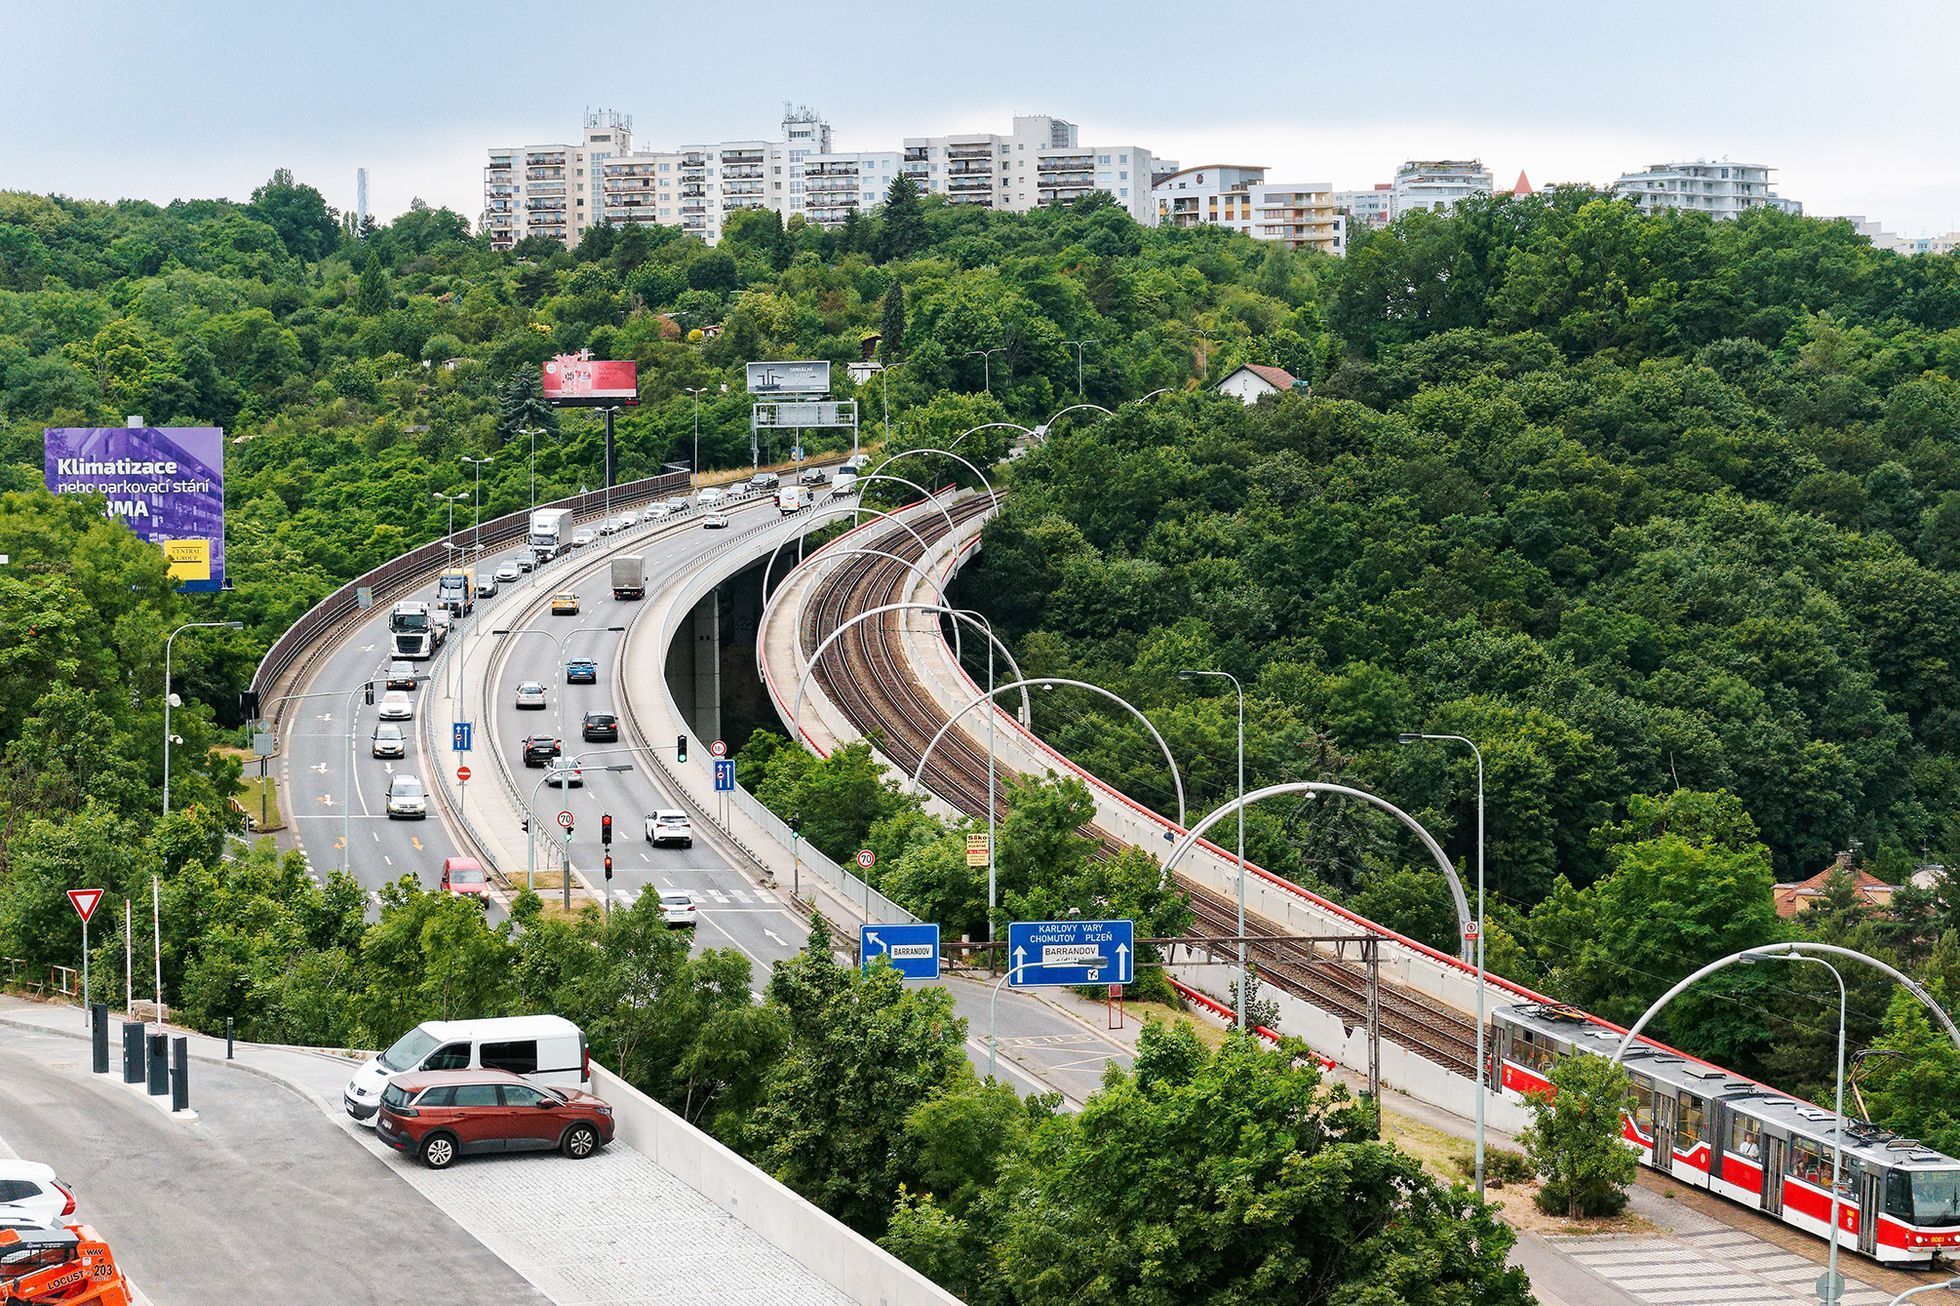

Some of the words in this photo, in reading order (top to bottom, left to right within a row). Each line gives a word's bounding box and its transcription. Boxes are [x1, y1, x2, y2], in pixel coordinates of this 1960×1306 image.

[58, 458, 177, 475] Klimatizace
[58, 480, 95, 493] nebo
[99, 479, 169, 493] parkovací
[173, 479, 210, 493] stání
[560, 814, 571, 823] 70
[861, 854, 872, 863] 70
[1039, 925, 1078, 933] KARLOVY
[1082, 924, 1104, 932] VARY
[1030, 934, 1075, 943] CHOMUTOV
[1085, 931, 1113, 941] PLZEŇ
[894, 947, 930, 956] BARRANDOV
[1045, 947, 1096, 956] BARRANDOV
[94, 1264, 113, 1276] 203
[47, 1270, 85, 1290] LOCUST
